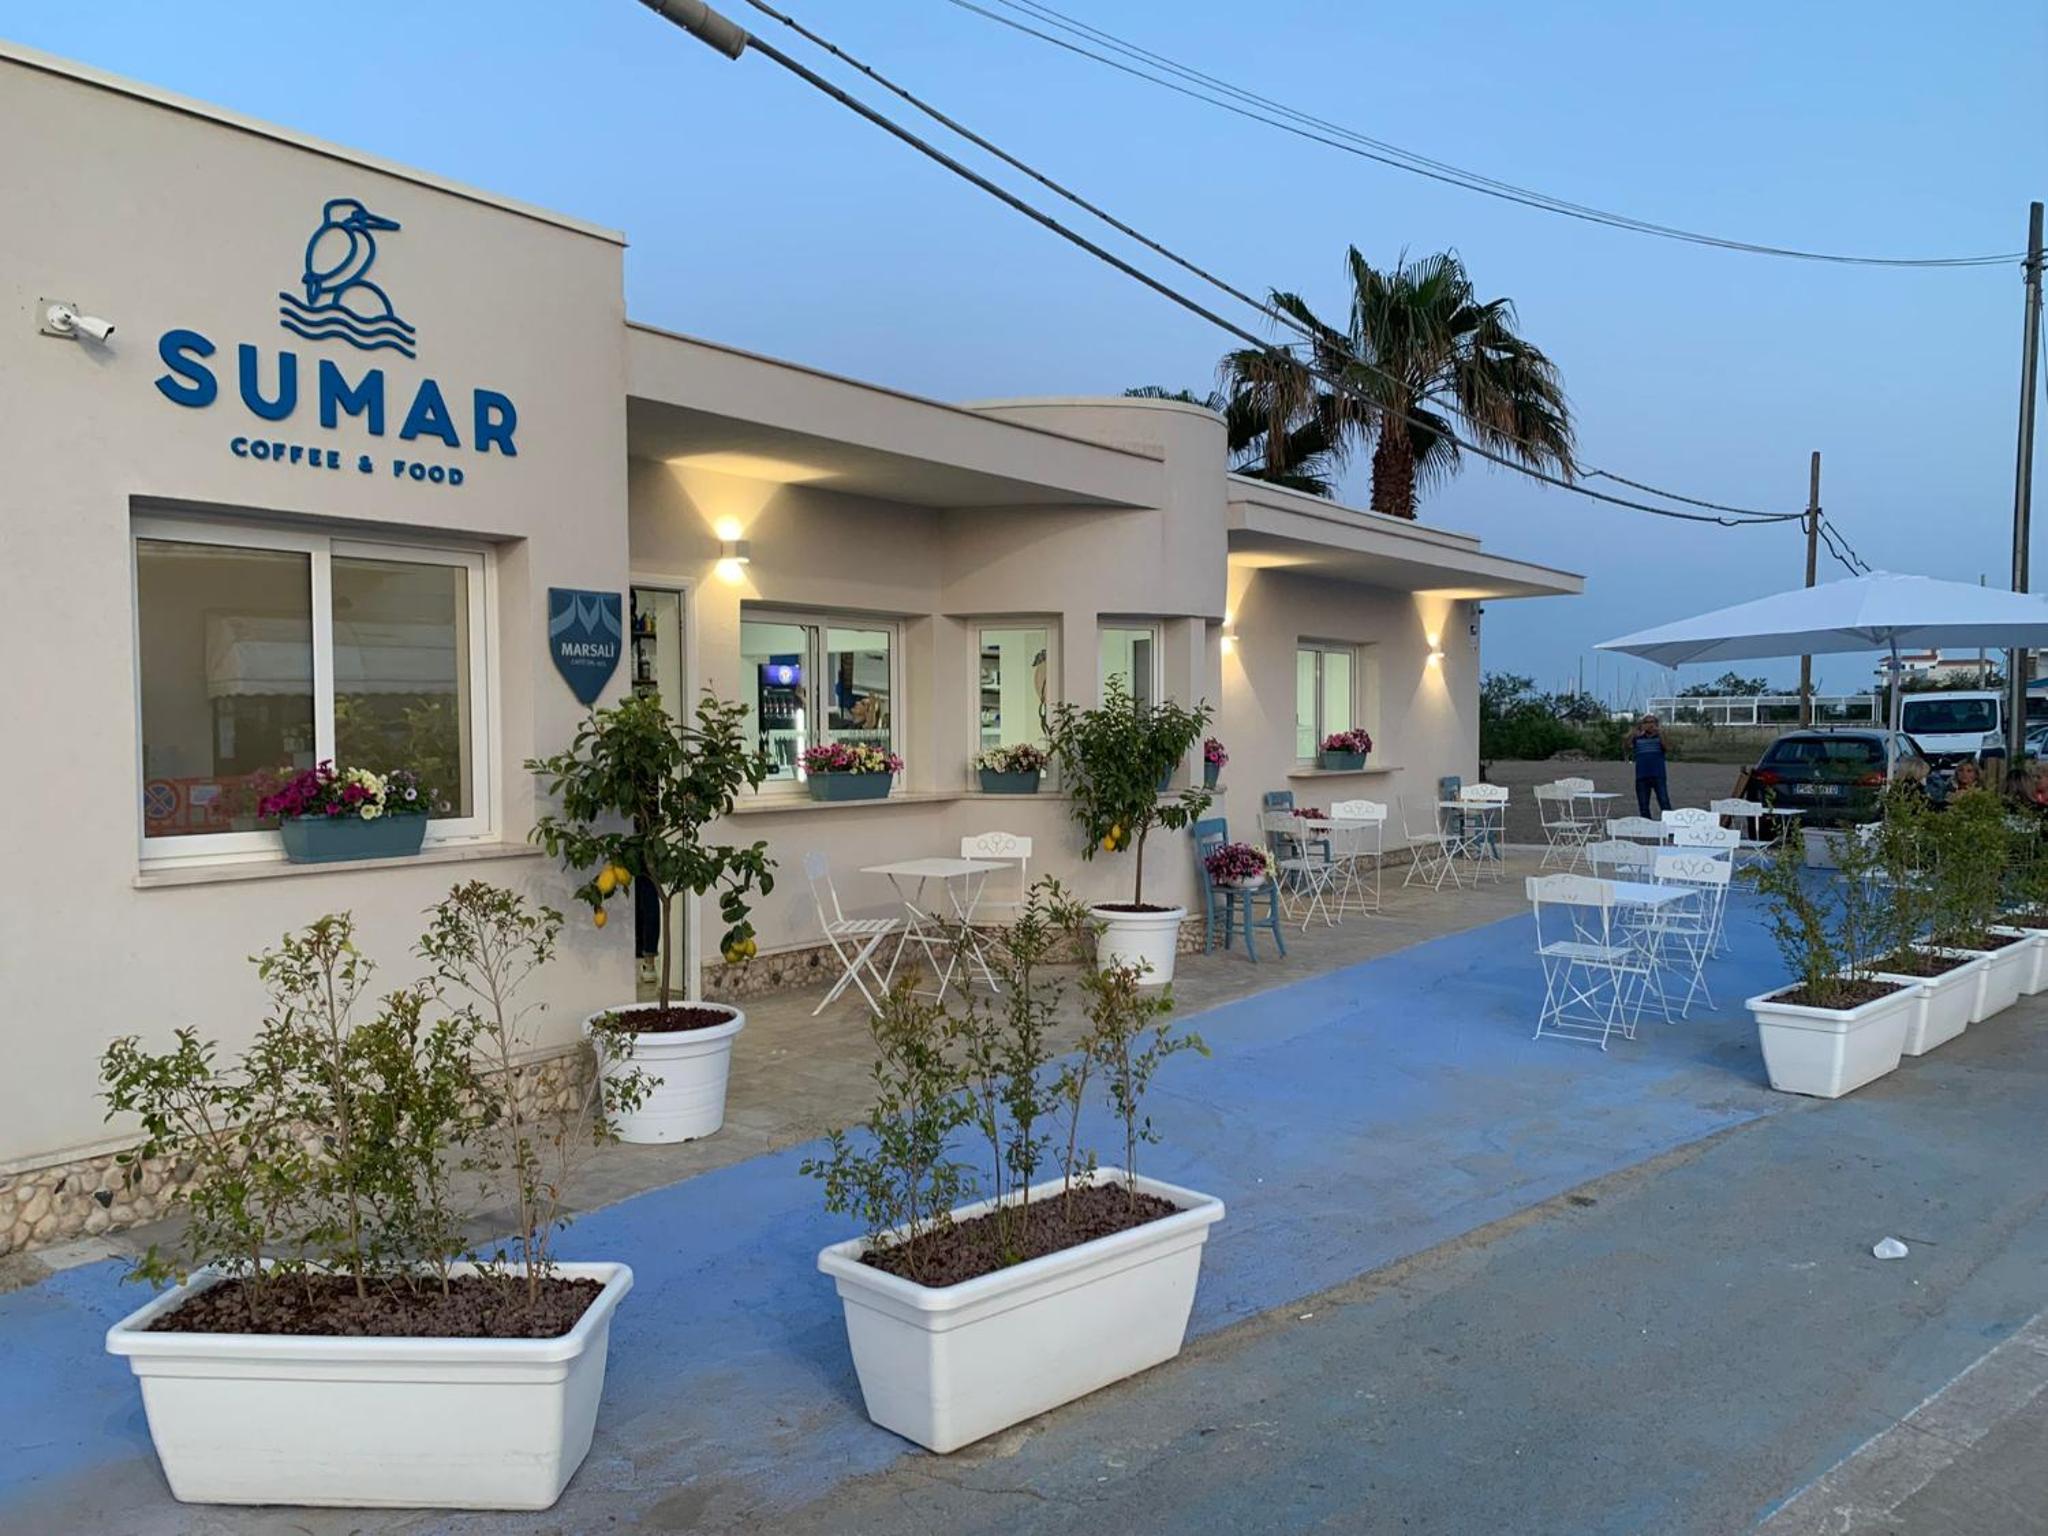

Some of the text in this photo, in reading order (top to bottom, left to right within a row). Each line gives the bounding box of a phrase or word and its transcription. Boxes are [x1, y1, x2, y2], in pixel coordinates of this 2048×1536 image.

[155, 329, 518, 456] SUMAR
[230, 436, 465, 486] COFFEE & FOOD
